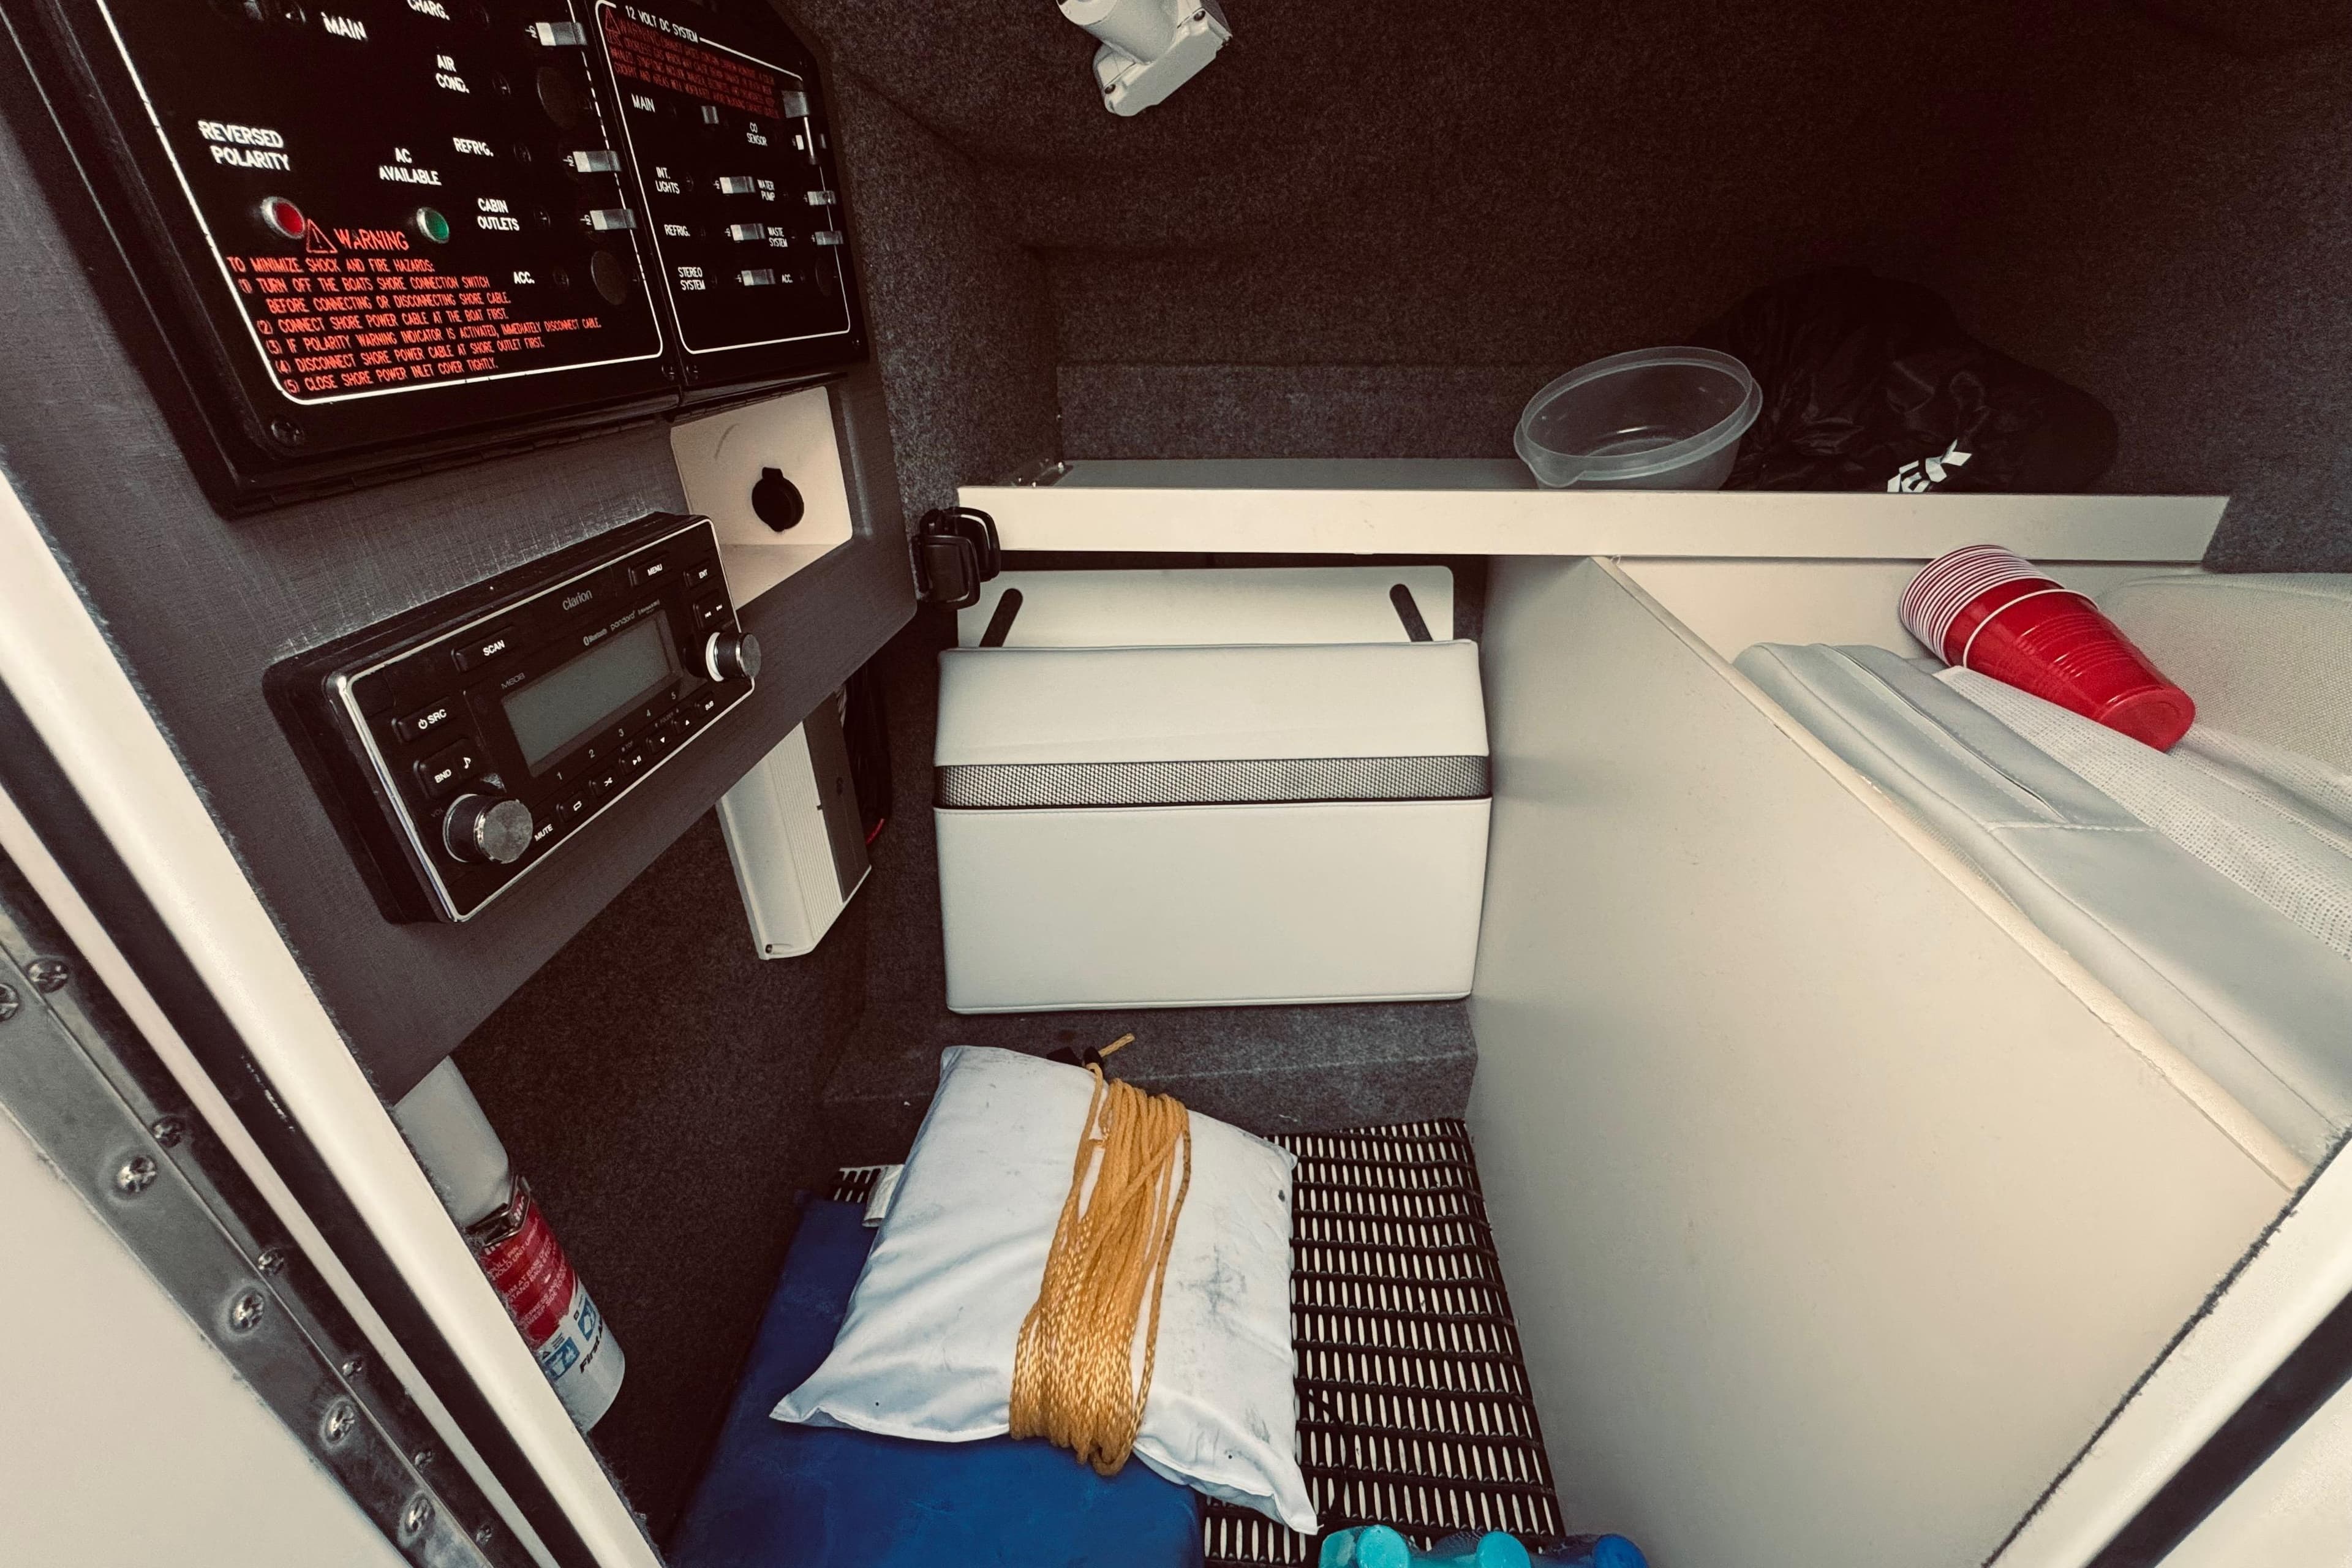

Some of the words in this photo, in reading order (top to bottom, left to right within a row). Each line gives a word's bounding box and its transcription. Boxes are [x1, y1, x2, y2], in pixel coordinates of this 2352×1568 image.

[320, 11, 368, 41] MAIN
[625, 5, 636, 20] 12
[638, 9, 657, 28] VOLT
[659, 18, 671, 33] DC
[672, 23, 698, 43] SYSTEM
[437, 55, 457, 72] AIR
[435, 73, 470, 94] COND.
[631, 93, 655, 113] MAIN
[197, 120, 284, 148] REVERSED
[750, 123, 758, 133] CO
[453, 137, 494, 157] REFRIG.
[747, 132, 768, 147] SENSOR
[210, 145, 291, 172] POLARITY
[394, 147, 413, 164] AC
[379, 165, 442, 186] AVAILABLE
[656, 166, 671, 179] INT.
[655, 180, 680, 194] LIGHTS
[757, 179, 775, 190] WATER
[761, 190, 775, 201] PUMP
[477, 198, 509, 214] CABIN
[477, 216, 520, 232] OUTLETS
[664, 224, 690, 237] REFRIG.
[767, 227, 785, 237] WASTE
[333, 228, 410, 251] WARNING
[769, 238, 788, 247] SYSTEM
[226, 256, 246, 273] TO
[249, 256, 304, 273] MINIMIZE
[305, 257, 342, 273] SHOCK
[345, 257, 365, 273] AND
[368, 258, 391, 273] FIRE
[393, 258, 435, 273] HAZARDS:
[677, 266, 703, 278] STEREO
[256, 277, 288, 294] TURN
[292, 277, 312, 293] OFF
[317, 277, 340, 293] THE
[341, 276, 374, 292] BOATS
[376, 276, 407, 291] SHORE
[409, 276, 459, 290] CONNECTION
[461, 275, 491, 288] SWITCH
[513, 271, 535, 285] ACC.
[680, 279, 706, 291] SYSTEM
[782, 274, 793, 284] ACC.
[265, 297, 311, 314] BEFORE
[313, 295, 373, 312] CONNECTING
[375, 294, 391, 309] OR
[393, 293, 456, 309] DISCONNECTING
[459, 292, 484, 306] SHORE
[486, 291, 511, 304] CABLE.
[257, 319, 274, 335] (2)
[277, 317, 326, 334] CONNECT
[329, 314, 363, 331] SHORE
[365, 312, 399, 328] POWER
[402, 311, 430, 326] CABLE
[432, 310, 443, 324] AT
[445, 309, 463, 323] THE
[464, 308, 484, 323] BOAT
[486, 307, 510, 321] FIRST.
[265, 339, 283, 355] (3)
[285, 337, 298, 354] IF
[302, 334, 353, 352] POLARITY
[355, 331, 398, 348] WARNING
[400, 328, 444, 344] INDICATOR
[445, 326, 456, 341] IS
[459, 323, 500, 339] ACTIVATED,
[500, 321, 542, 336] IMMEDIATELY
[543, 318, 580, 333] DISCONNECT
[581, 317, 602, 330] CABLE.
[276, 359, 292, 374] (4)
[294, 353, 357, 373] DISCONNECT
[360, 350, 393, 366] SHORE
[394, 347, 426, 362] POWER
[428, 344, 454, 359] CABLE
[458, 342, 467, 356] AT
[470, 341, 495, 355] SHORE
[497, 338, 522, 352] OUTLET
[524, 336, 546, 350] FIRST.
[284, 379, 301, 394] (5)
[304, 374, 339, 392] CLOSE
[341, 370, 374, 387] SHORE
[375, 366, 408, 383] POWER
[410, 363, 435, 379] INLET
[437, 360, 465, 375] COVER
[467, 357, 499, 372] TIGHTLY.
[647, 563, 663, 576] MENU
[483, 639, 505, 657] SCAN
[671, 691, 676, 699] 5
[427, 709, 447, 725] SRC
[619, 729, 624, 737] 3
[589, 749, 595, 758] 2
[434, 769, 452, 784] BND
[556, 772, 562, 780] 1
[534, 823, 554, 842] MUTE
